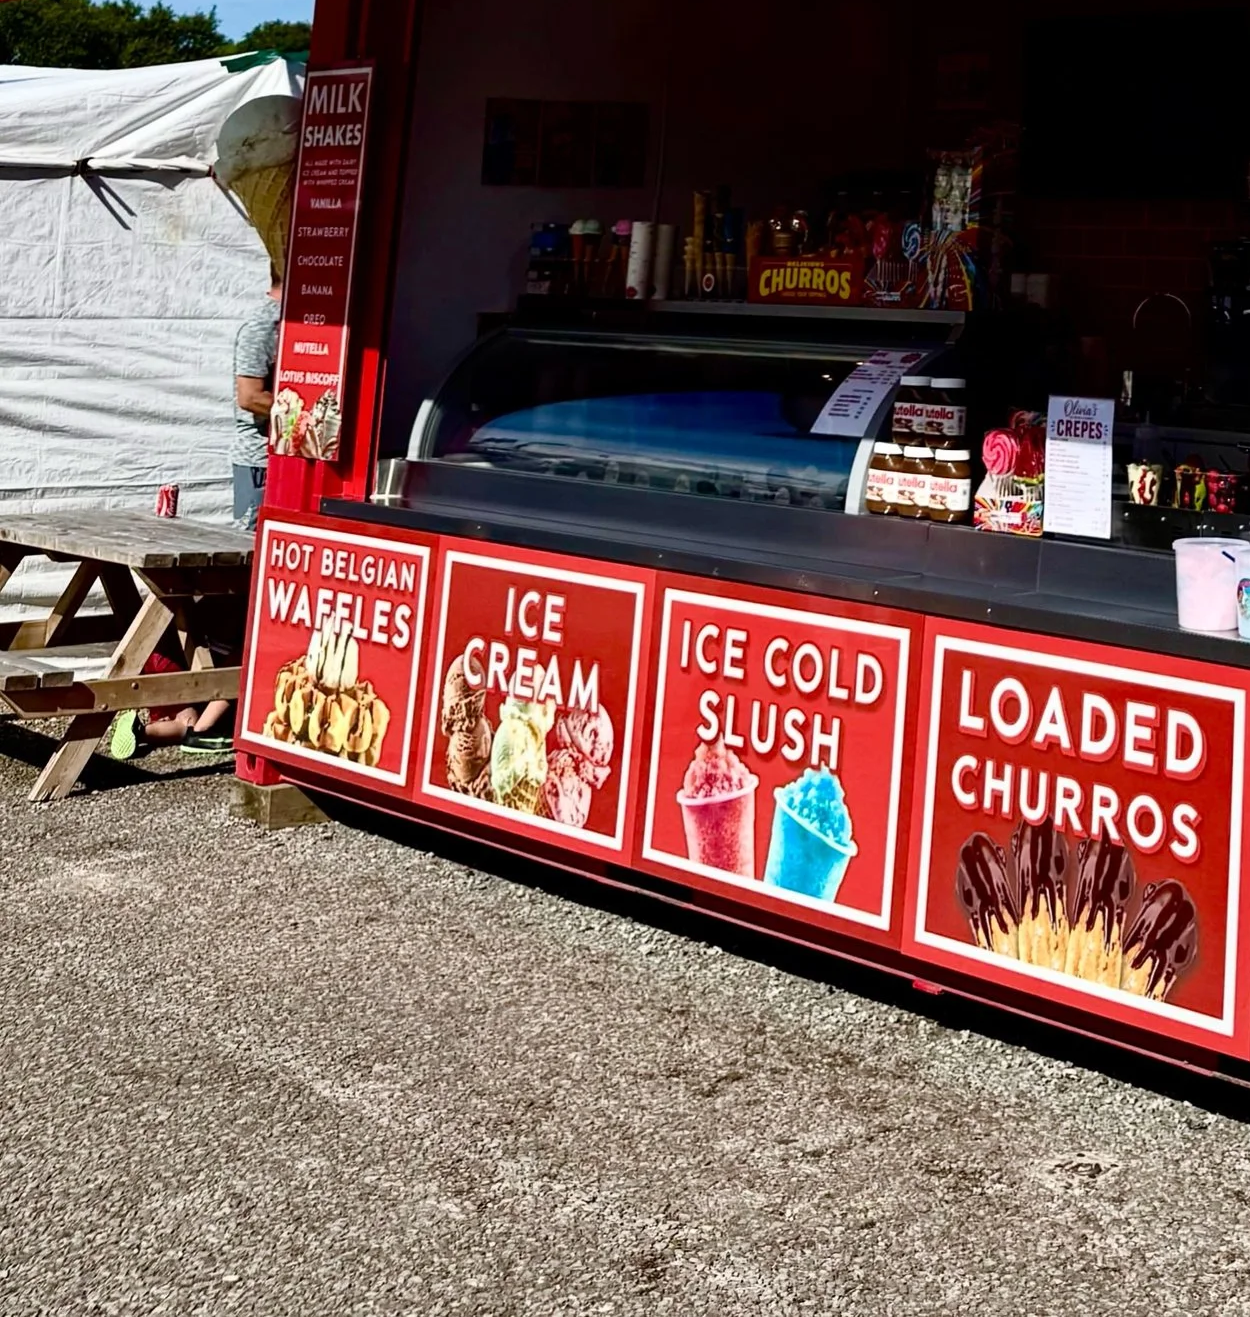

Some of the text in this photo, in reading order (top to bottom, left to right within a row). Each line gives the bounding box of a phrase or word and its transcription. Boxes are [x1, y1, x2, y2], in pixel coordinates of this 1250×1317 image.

[308, 82, 365, 115] MILK
[304, 123, 362, 148] SHAKES
[310, 197, 342, 209] VANILLA
[297, 226, 350, 238] STRAWBERRY
[297, 255, 344, 267] CHOCOLATE
[301, 284, 333, 296] BANANA
[759, 268, 852, 299] CHURROS
[303, 313, 326, 325] OREO
[293, 341, 329, 356] NUTELLA
[279, 370, 340, 386] LOTUS BISCOFF
[1064, 399, 1099, 418] Olivia's
[1056, 419, 1103, 440] CREPES
[270, 538, 416, 593] HOT BELGIAN
[267, 578, 412, 649] WAFFLES
[504, 587, 568, 644] ICE
[463, 637, 600, 715] CREAM
[680, 619, 884, 707] ICE COLD
[697, 690, 841, 771] SLUSH
[958, 668, 1206, 780] LOADED
[951, 754, 1202, 863] CHURROS
